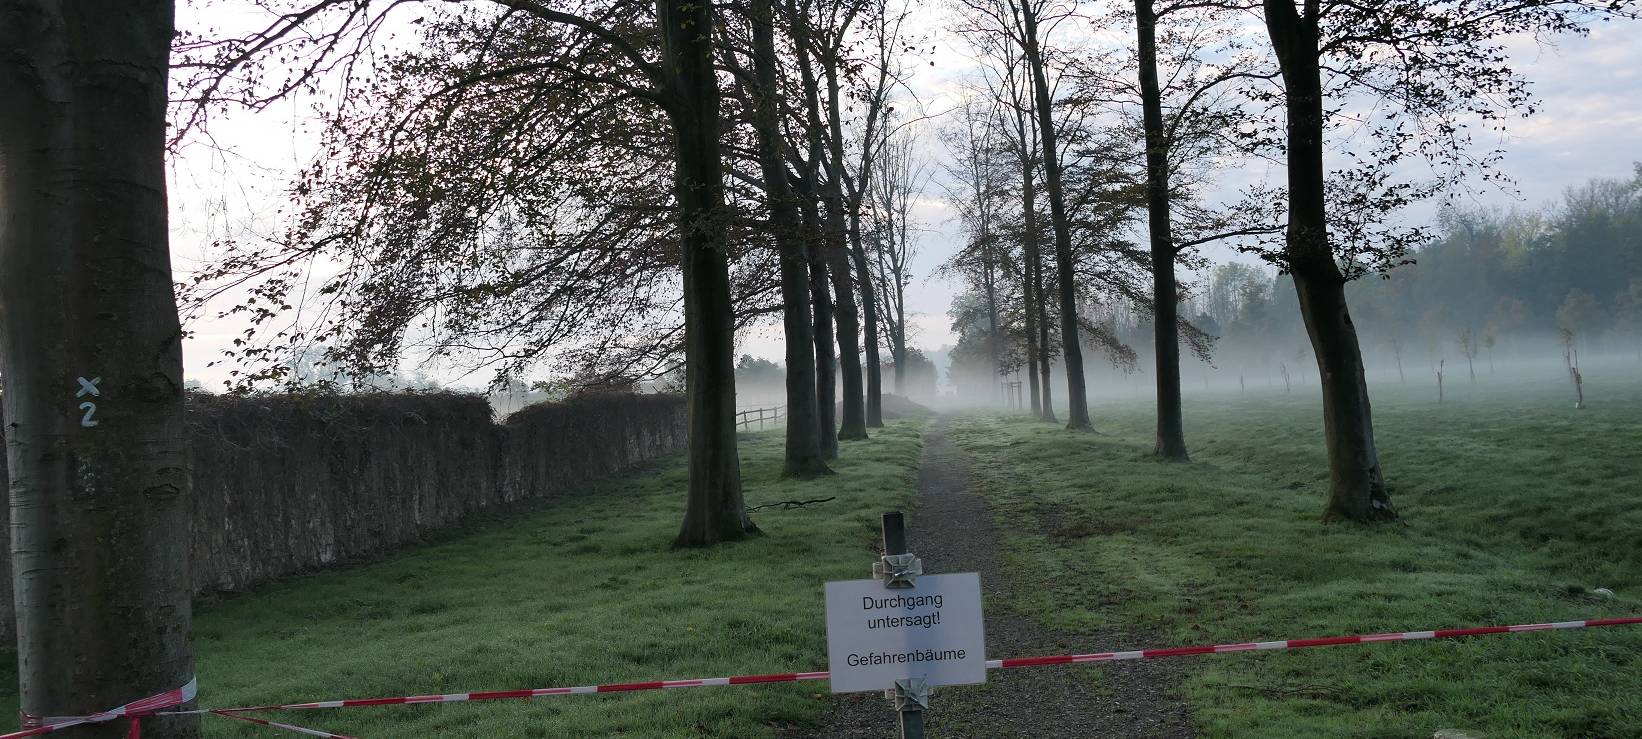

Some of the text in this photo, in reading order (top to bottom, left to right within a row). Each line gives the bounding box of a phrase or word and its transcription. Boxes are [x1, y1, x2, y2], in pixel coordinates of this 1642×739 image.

[79, 401, 98, 427] 2
[863, 594, 943, 610] Durchgang
[868, 612, 941, 629] untersagt!
[847, 649, 966, 667] Gefahrenbäume
